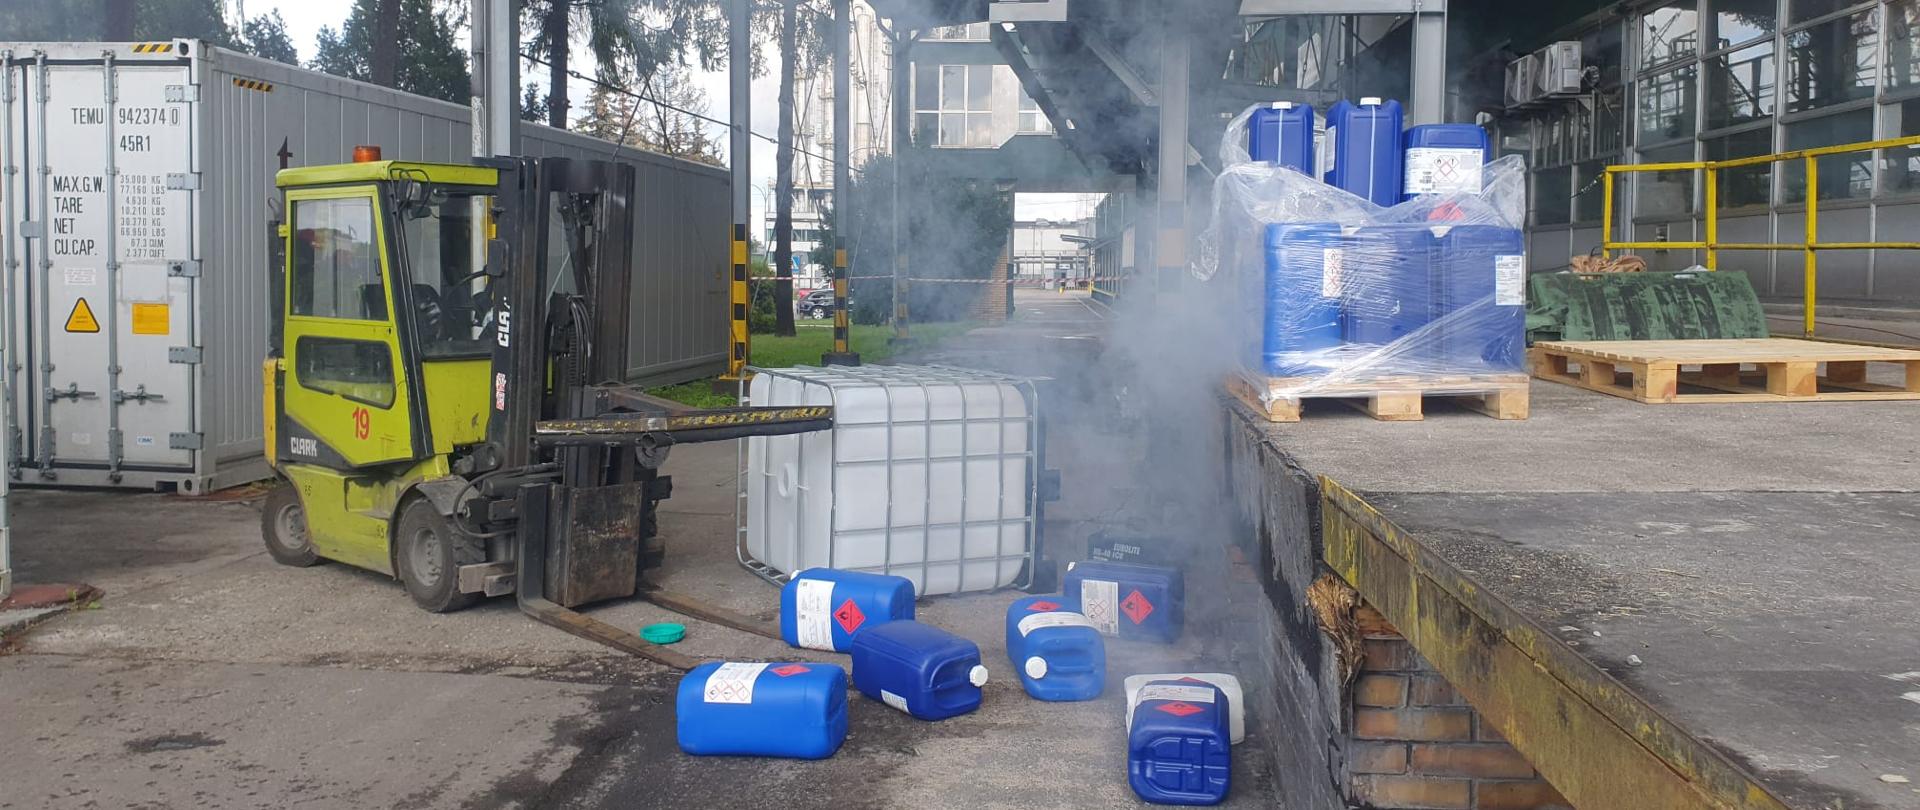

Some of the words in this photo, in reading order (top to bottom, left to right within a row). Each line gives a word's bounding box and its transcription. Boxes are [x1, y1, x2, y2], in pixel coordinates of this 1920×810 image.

[71, 107, 104, 124] TEMU
[119, 107, 166, 124] 942374
[171, 108, 179, 124] 0
[120, 135, 151, 152] 45R1
[53, 176, 106, 193] MAX.G.W.
[151, 175, 161, 185] KG
[151, 185, 165, 195] LBS
[54, 197, 84, 213] TARE
[151, 196, 161, 206] KG
[151, 207, 166, 216] LBS
[54, 218, 75, 234] NET
[151, 217, 161, 227] KG
[151, 227, 166, 237] LBS
[54, 239, 98, 256] CU.CAP.
[497, 295, 511, 348] CLA
[352, 406, 370, 440] 19
[290, 437, 318, 457] CLARK
